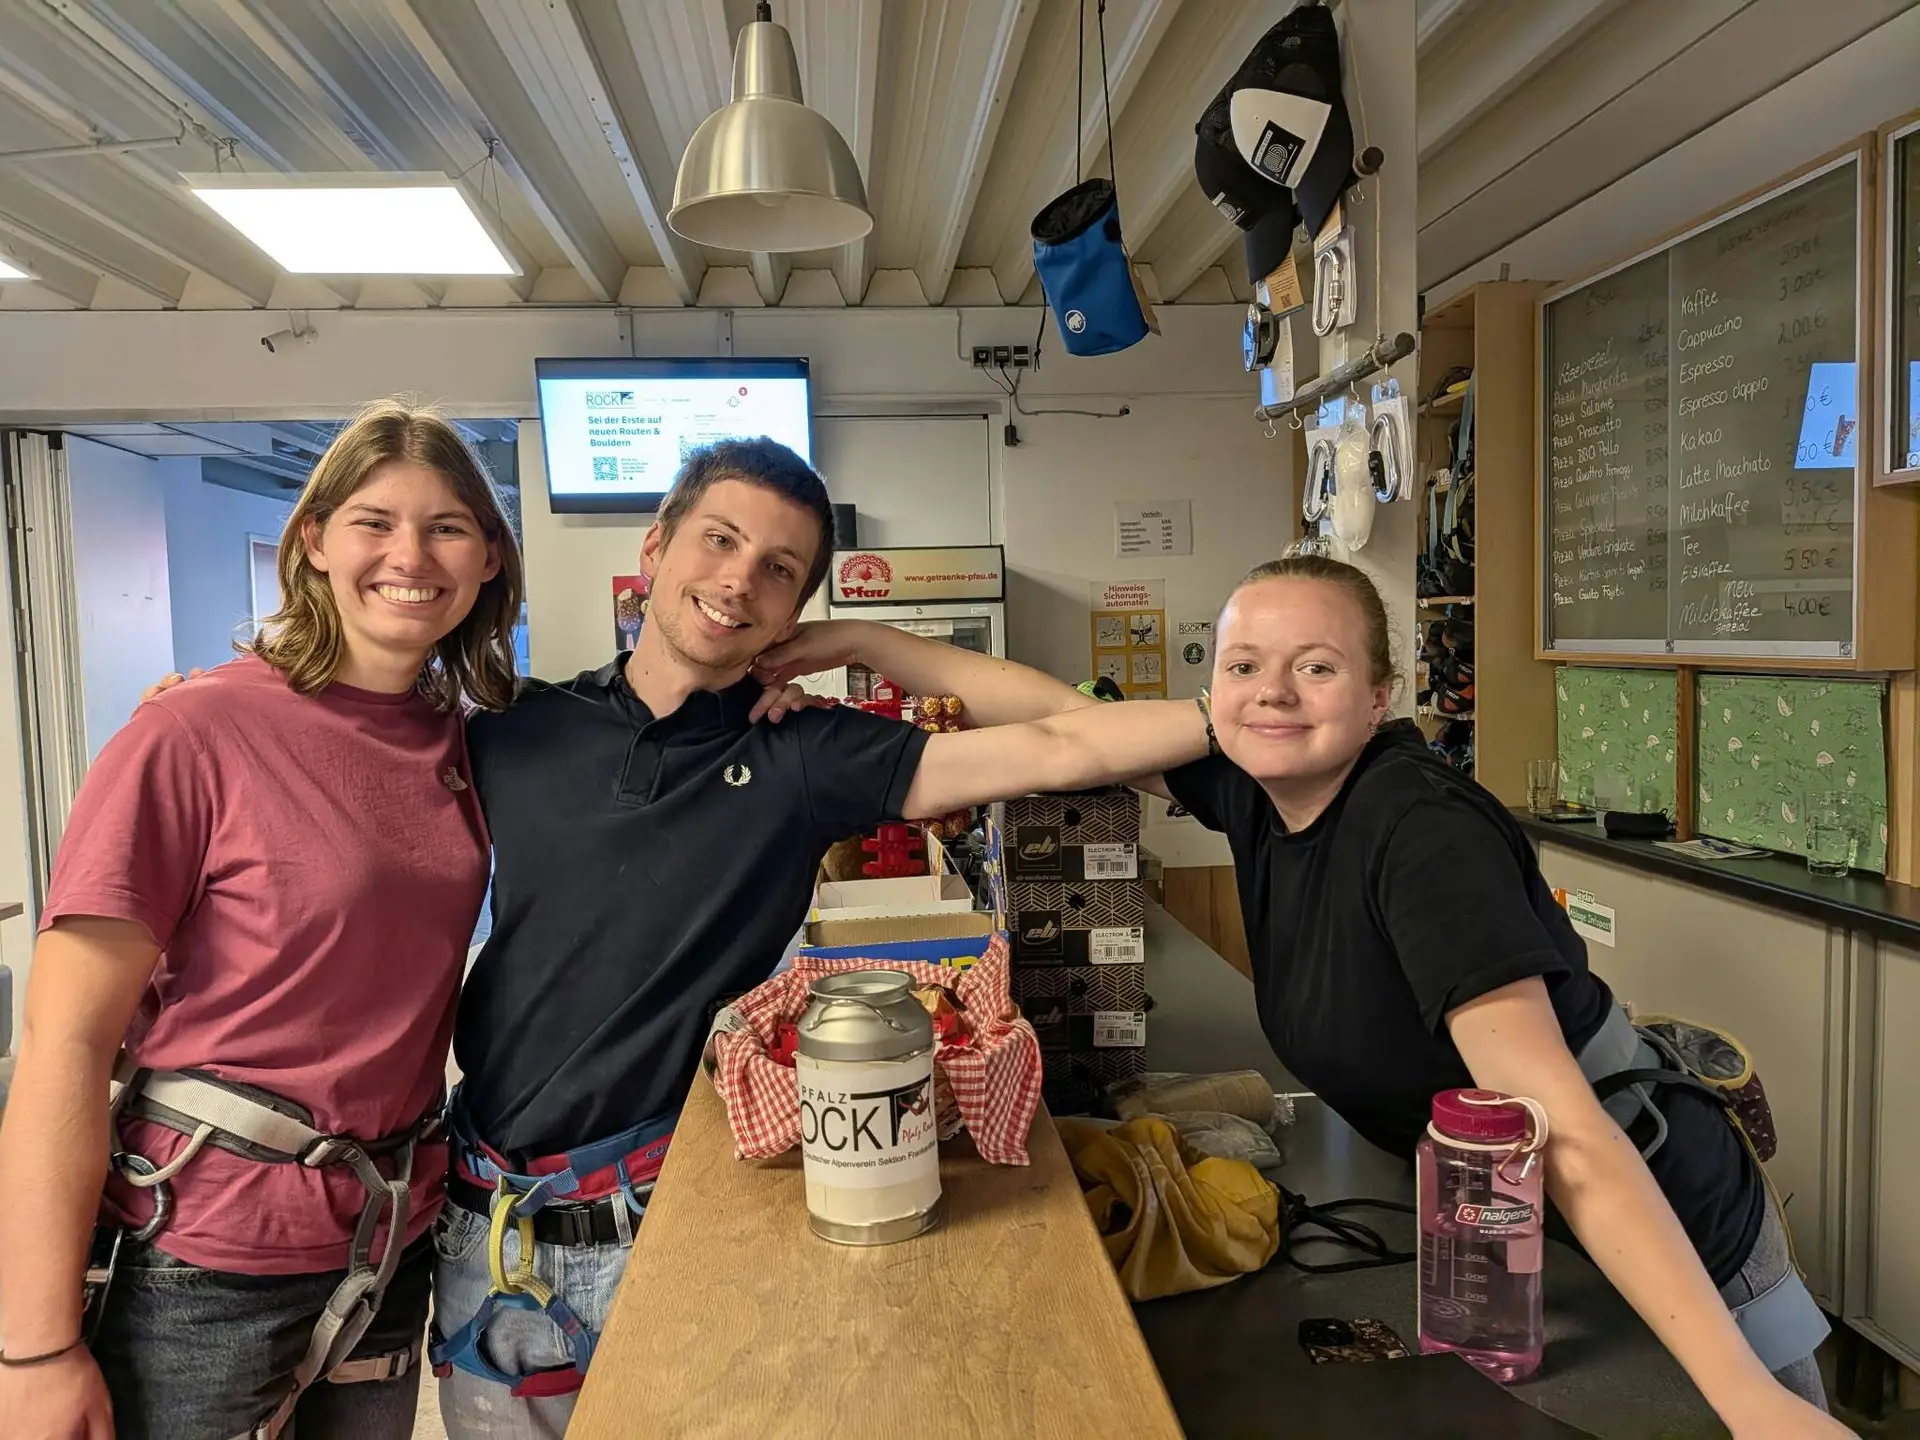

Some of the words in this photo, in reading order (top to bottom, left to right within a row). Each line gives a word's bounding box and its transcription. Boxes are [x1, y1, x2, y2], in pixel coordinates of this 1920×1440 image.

[1680, 287, 1718, 316] Kaffee
[1677, 316, 1743, 351] Cappuccino
[1679, 354, 1735, 384] Espresso
[1678, 390, 1729, 418] Espresso
[1732, 376, 1770, 403] doppio
[588, 416, 603, 425] Sei
[605, 416, 619, 425] der
[622, 416, 645, 425] Erste
[647, 416, 662, 425] auf
[1553, 412, 1575, 429] Pizza
[1580, 398, 1616, 419] Salame
[589, 428, 617, 436] neuen
[619, 428, 650, 436] Routen
[1553, 435, 1573, 450] Pizza
[1576, 416, 1622, 440] Prosciutto
[1680, 428, 1722, 453] Kakao
[590, 439, 631, 447] Bouldern
[1552, 456, 1574, 472] Pizza
[1577, 445, 1596, 463] BBQ
[1597, 440, 1619, 458] Pollo
[1715, 450, 1772, 481] Macchiato
[1552, 476, 1573, 490] Pizza
[1680, 491, 1751, 526] Milchkaffee
[1680, 534, 1702, 557] Tee
[1553, 550, 1574, 565] Pizza
[904, 572, 998, 584] www.getraenke-pfau.de
[1108, 584, 1146, 592] Hinweise
[840, 586, 890, 598] Pfau
[1103, 593, 1151, 601] Sicherungs-
[1106, 600, 1149, 608] automaten
[1679, 594, 1763, 631] Milchkaffee
[801, 1085, 847, 1105] PFALZ
[800, 1090, 900, 1152] OCKT
[831, 1156, 876, 1168] Alpenverein
[878, 1155, 906, 1166] Sektion
[1481, 1208, 1531, 1224] nalgene
